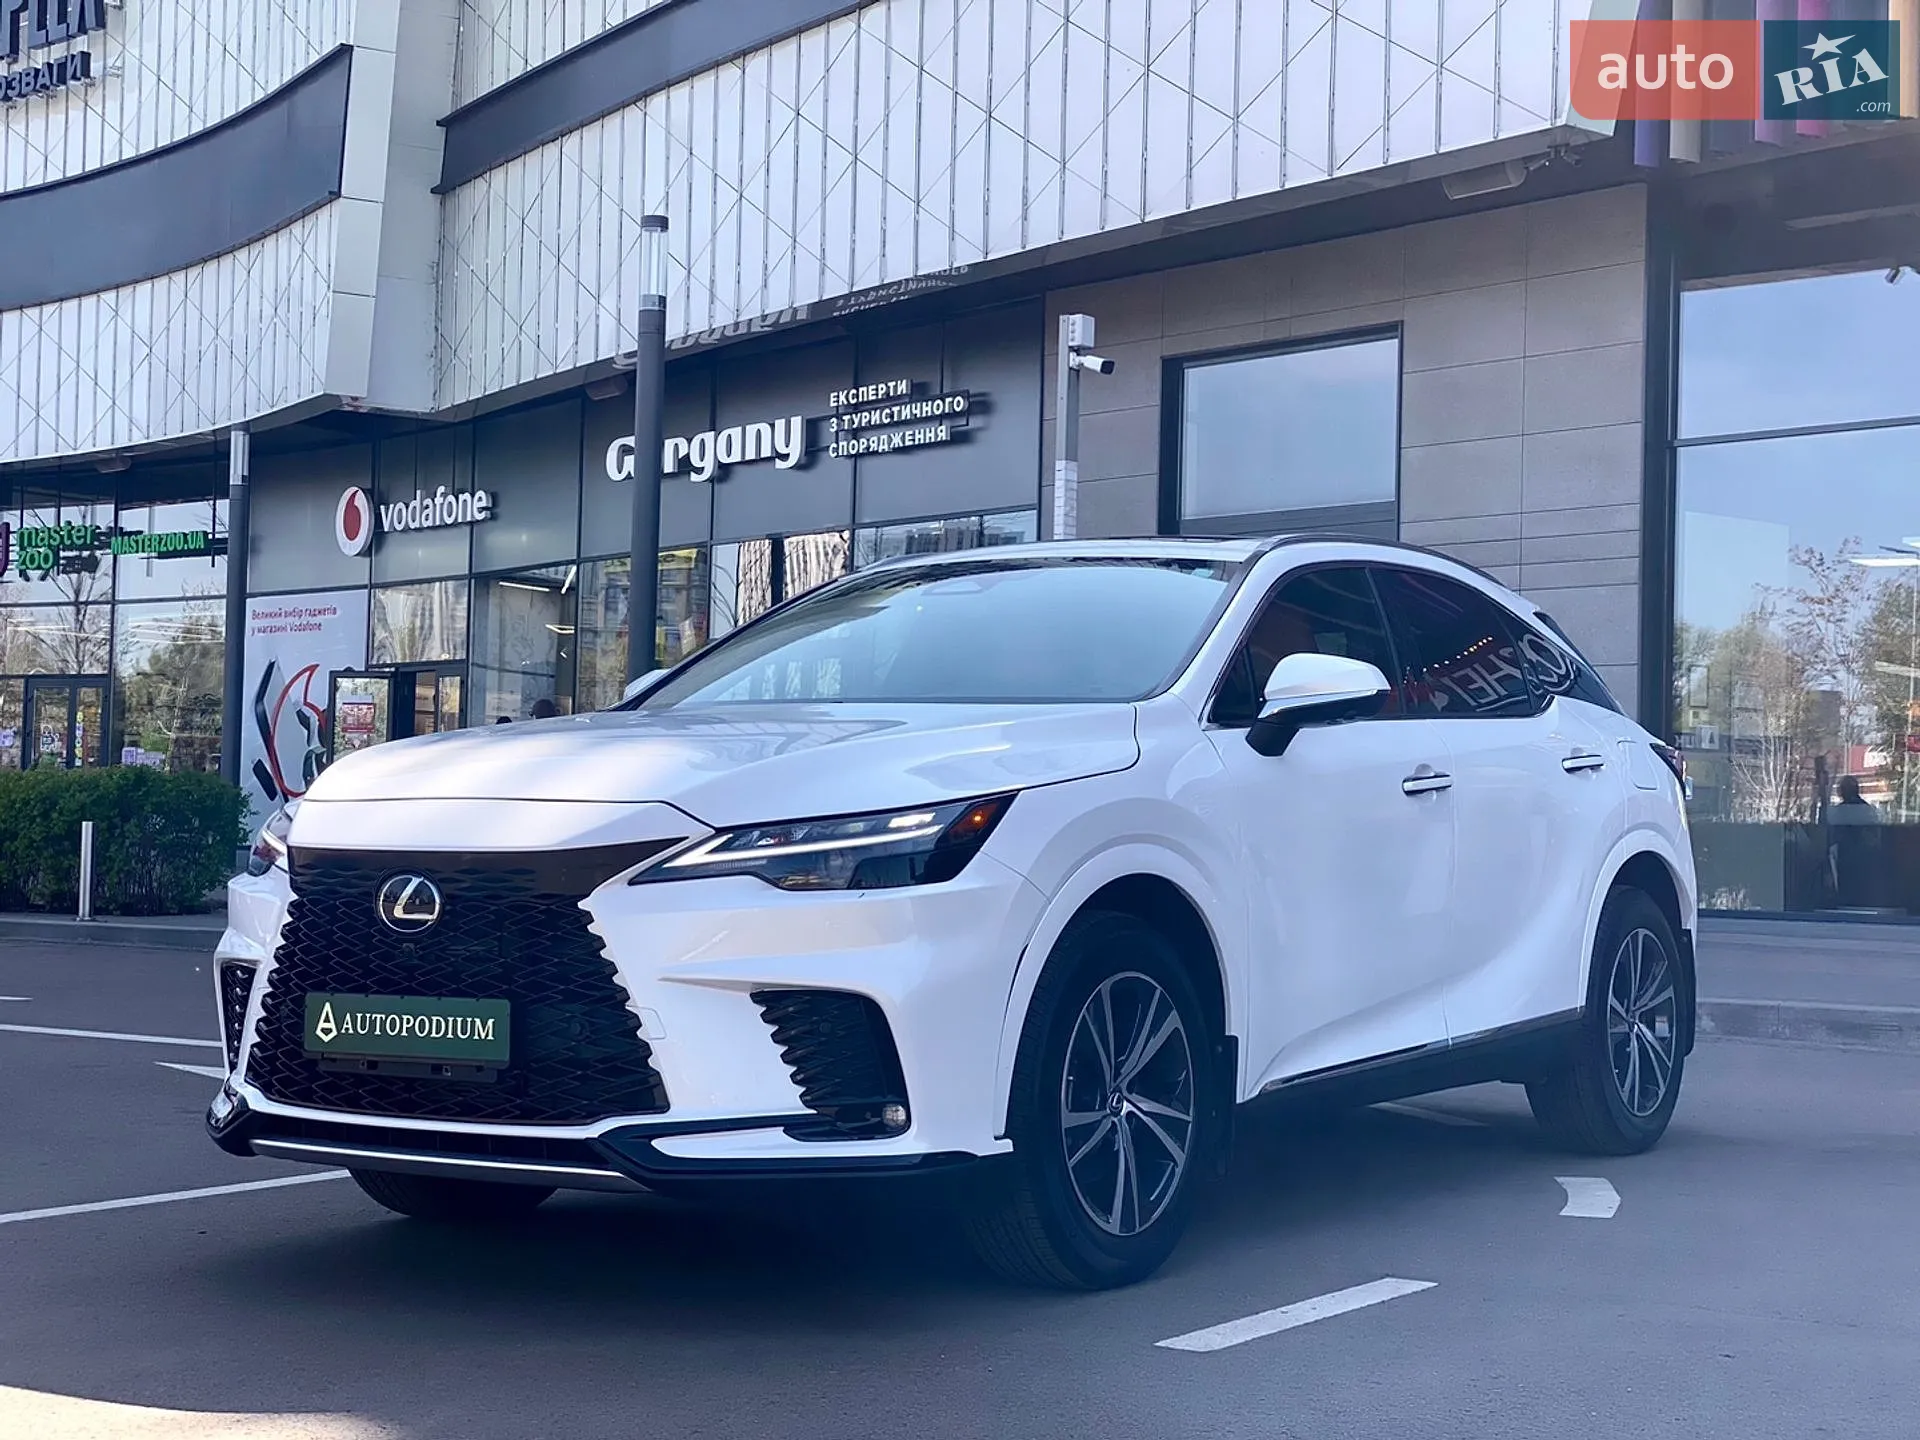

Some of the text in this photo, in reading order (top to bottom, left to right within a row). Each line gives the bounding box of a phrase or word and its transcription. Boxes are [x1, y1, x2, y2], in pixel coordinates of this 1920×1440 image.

[829, 379, 908, 407] ЕКСПЕРТИ
[829, 395, 964, 432] З ТУРИСТИЧНОГО
[605, 415, 802, 482] Grgany
[828, 425, 947, 458] СПОРЯДЖЕННЯ
[379, 485, 489, 532] vodafone
[16, 524, 96, 547] master
[111, 531, 205, 555] MASTERZOO.UA
[16, 548, 54, 570] zoo
[251, 605, 338, 620] Великий вибір гаджетів
[257, 624, 288, 634] магазині
[288, 621, 322, 632] Vodafone
[340, 1012, 496, 1041] AUTOPODIUM
